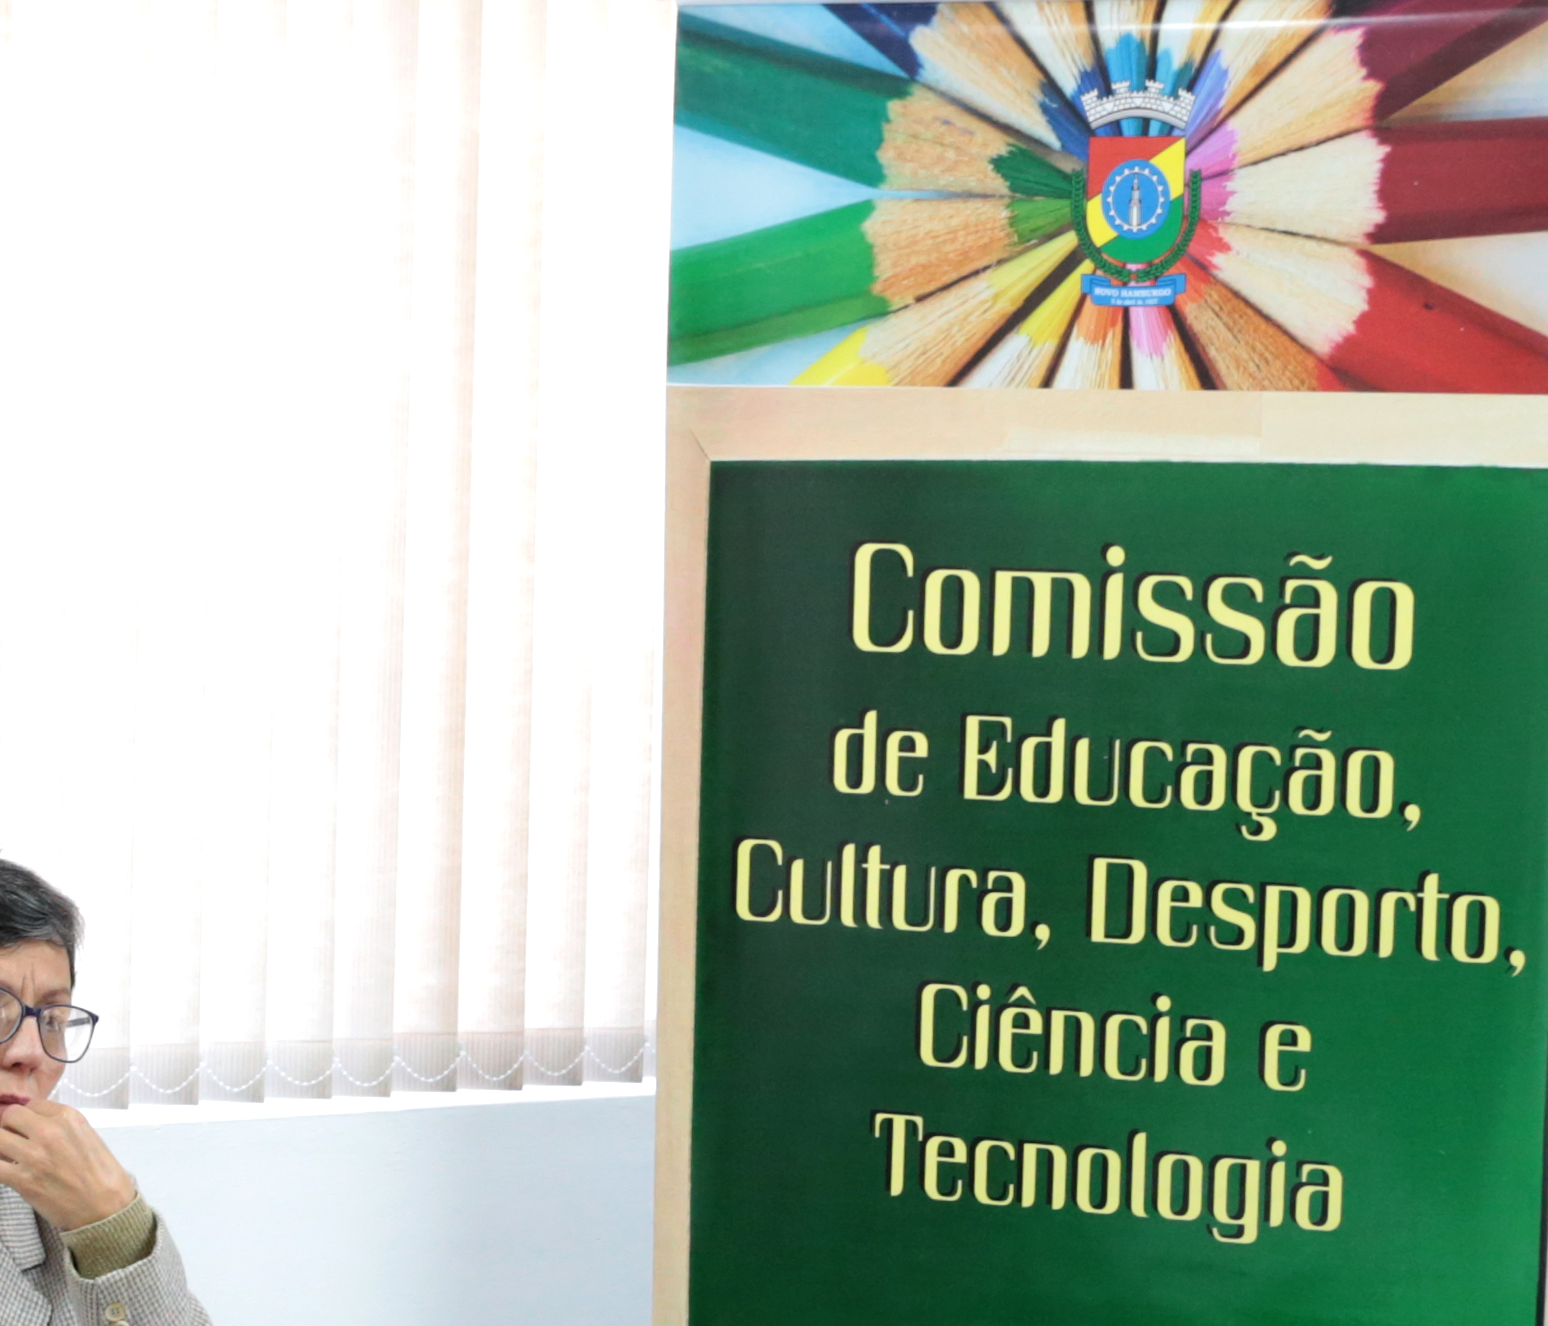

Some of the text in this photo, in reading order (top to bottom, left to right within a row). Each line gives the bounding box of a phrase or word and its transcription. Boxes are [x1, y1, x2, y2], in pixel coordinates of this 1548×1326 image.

[848, 541, 1417, 672] Comissão
[831, 708, 1423, 844] de Educação,
[734, 837, 1527, 977] Cultura, Desporto,
[918, 982, 1313, 1093] Ciência e
[872, 1111, 1344, 1246] Tecnologia
